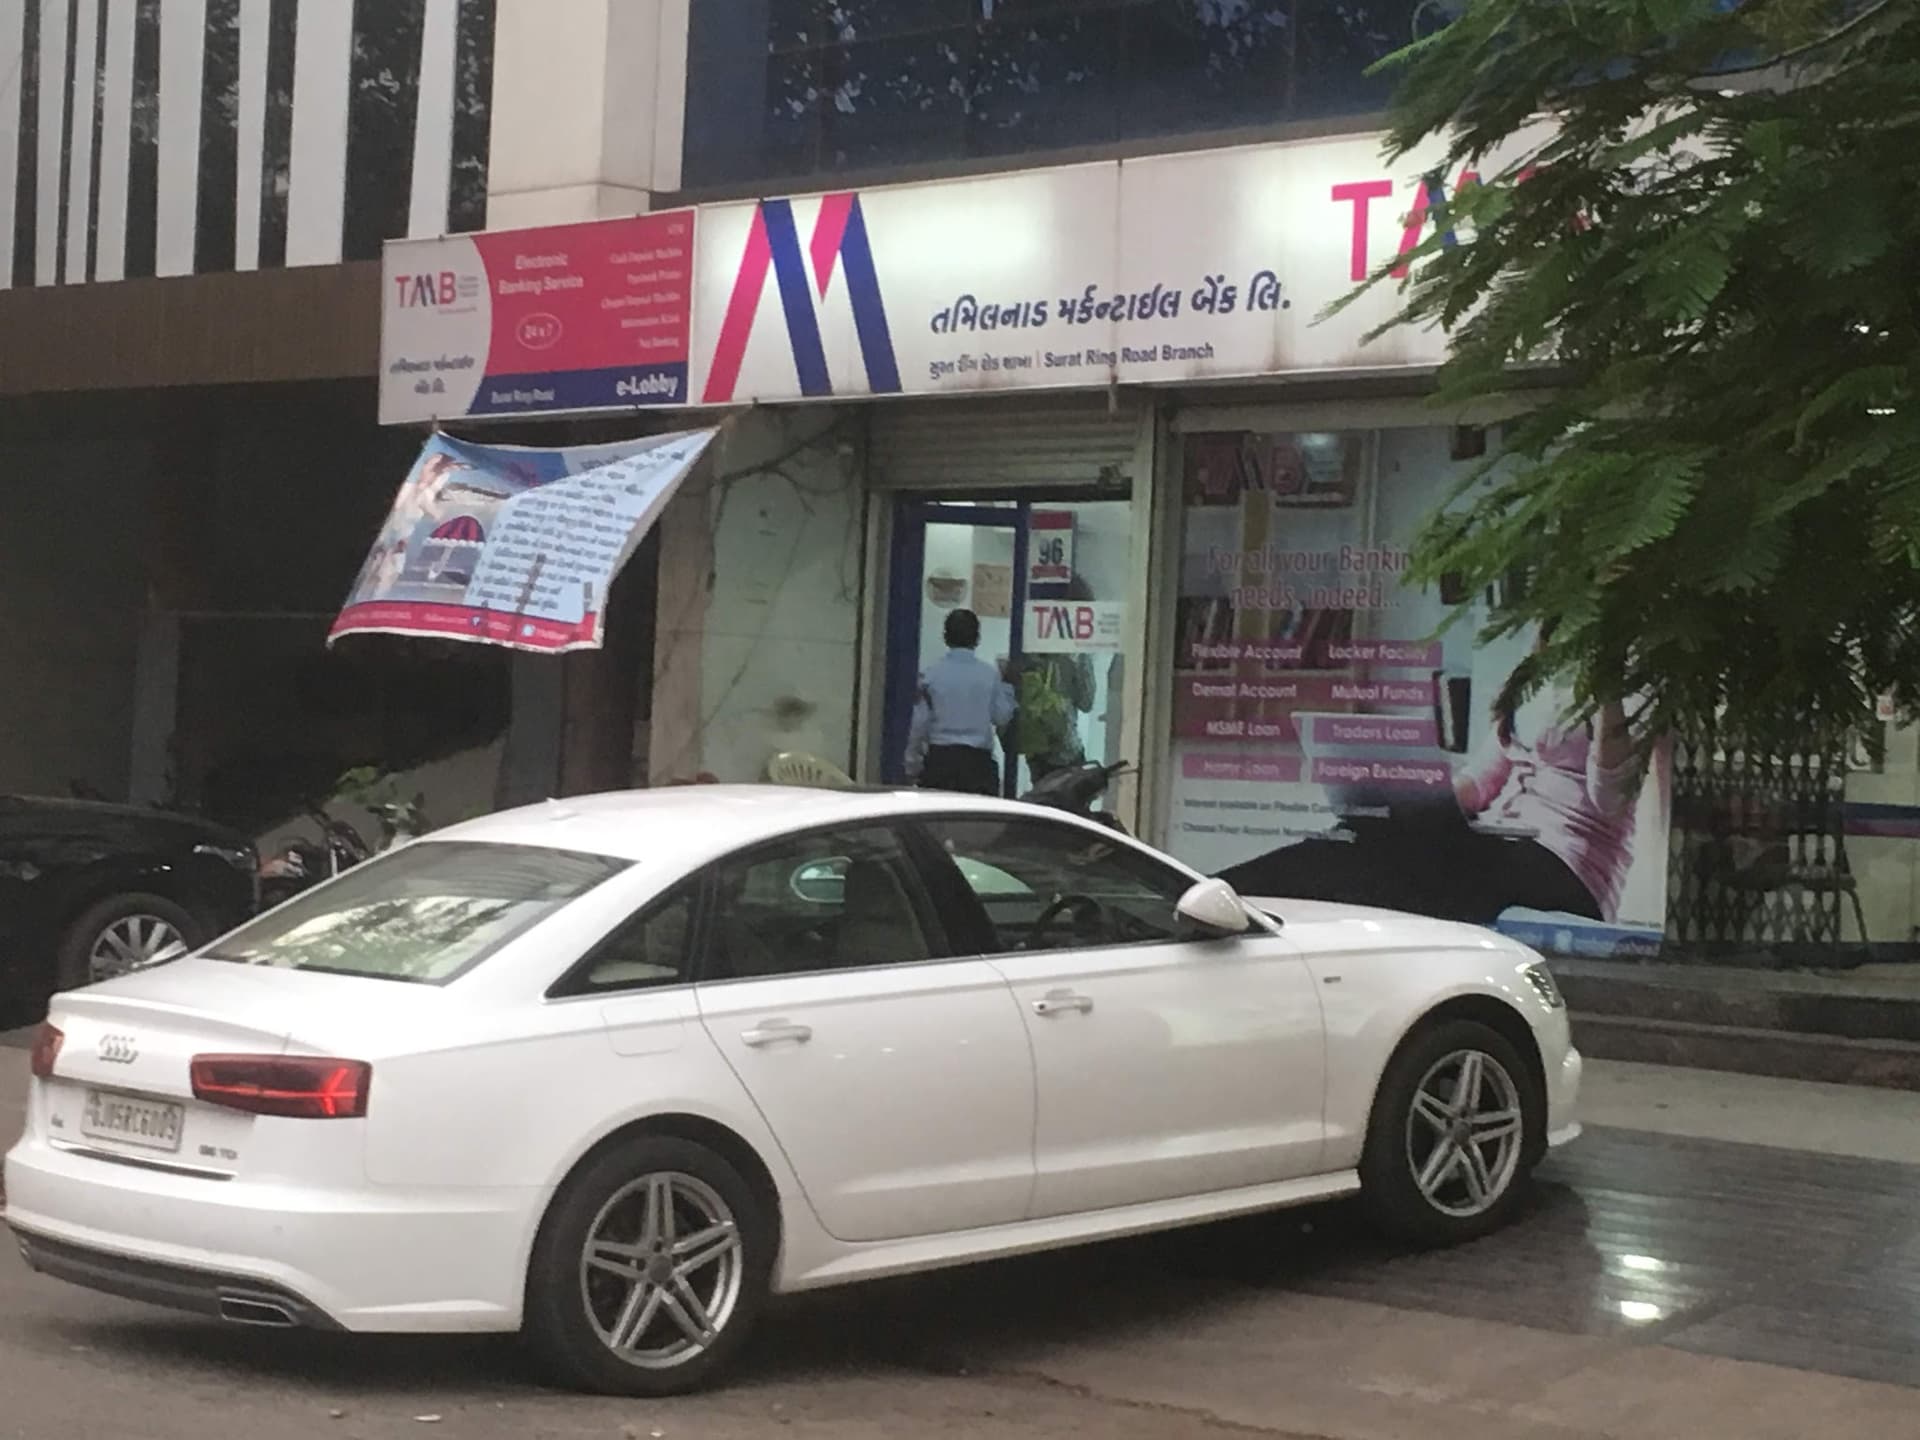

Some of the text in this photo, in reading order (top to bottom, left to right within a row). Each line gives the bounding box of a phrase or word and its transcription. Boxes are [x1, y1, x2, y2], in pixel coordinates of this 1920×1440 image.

[395, 271, 457, 308] TMB
[499, 279, 541, 296] Banking
[543, 276, 584, 291] Service
[931, 294, 1048, 334] તમિલનાડ
[1246, 269, 1290, 312] લિ.
[1044, 341, 1214, 368] Surat Ring Road Branch
[616, 373, 679, 398] e-Lobby
[1208, 544, 1416, 577] For all your Bankin
[1033, 605, 1094, 640] TMB
[1244, 644, 1302, 659] Account
[1328, 644, 1376, 659] Locker
[1192, 682, 1297, 697] Demat Account
[1331, 685, 1425, 700] Mutual Funds
[1249, 721, 1280, 736] Loan
[1332, 724, 1420, 740] Traders Loan
[1318, 762, 1445, 785] Foreign Exchange
